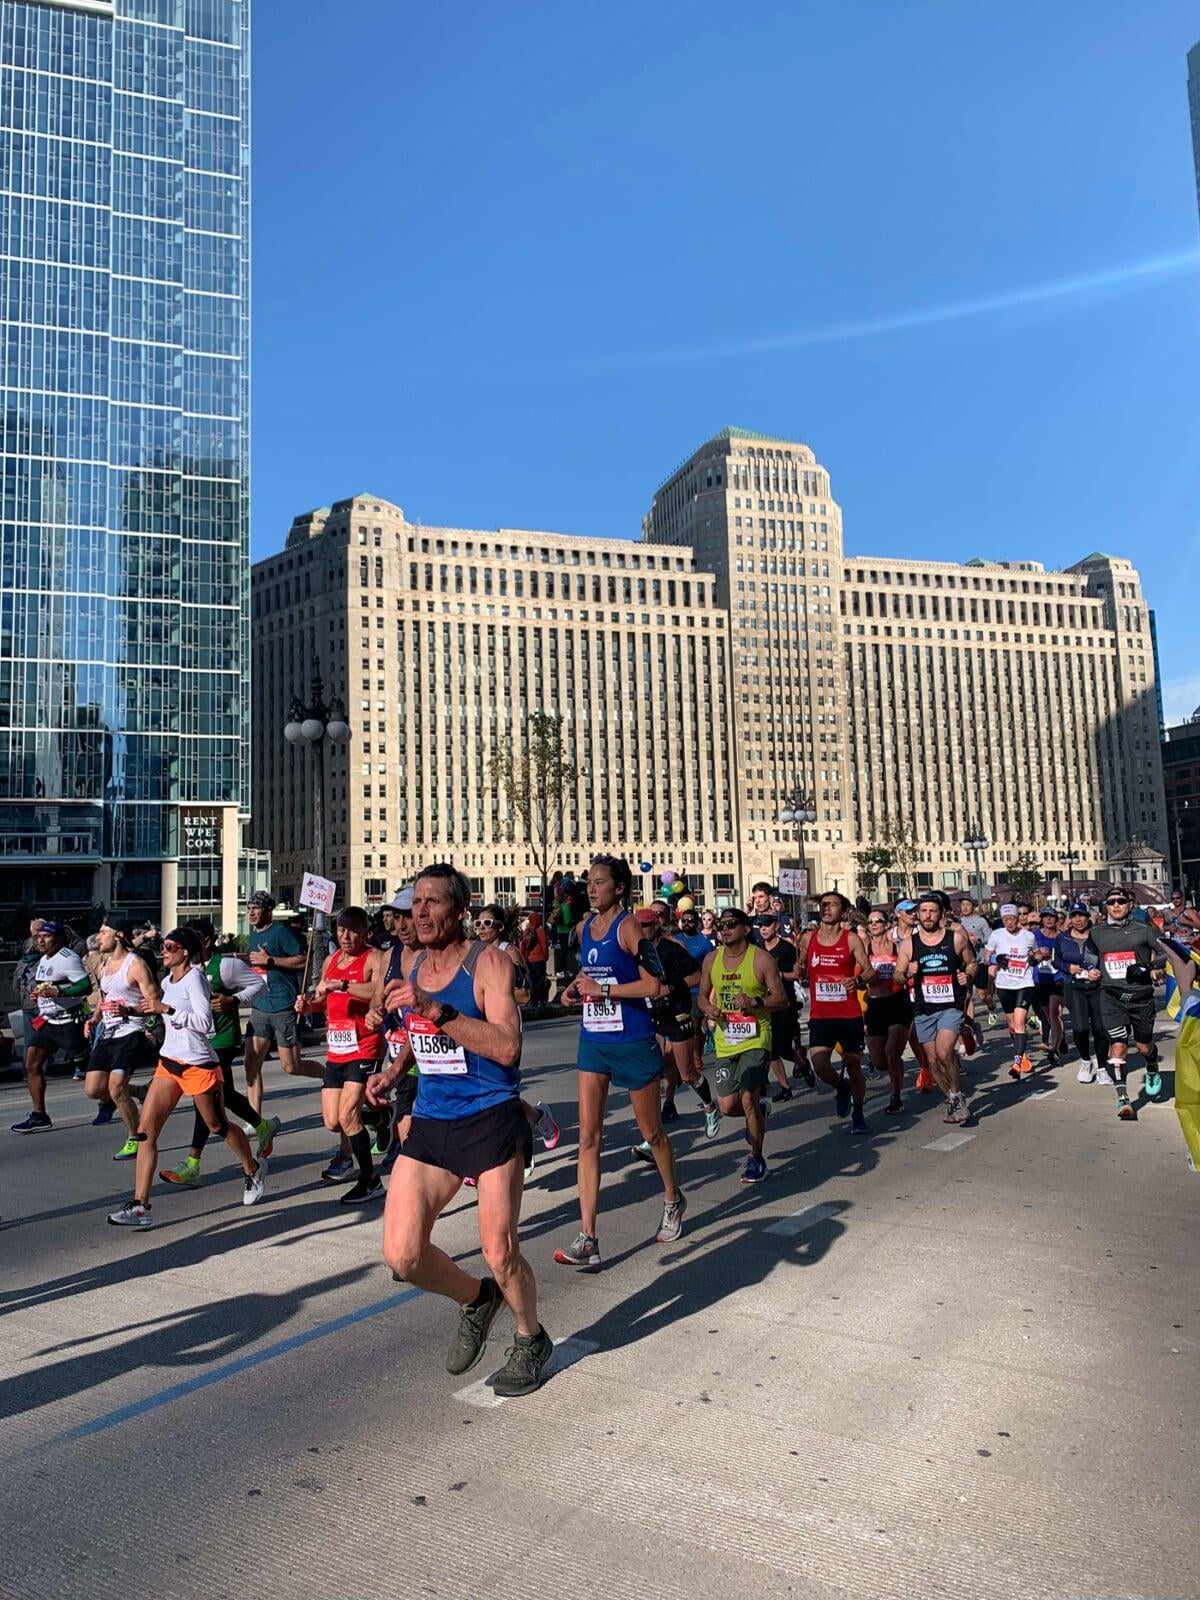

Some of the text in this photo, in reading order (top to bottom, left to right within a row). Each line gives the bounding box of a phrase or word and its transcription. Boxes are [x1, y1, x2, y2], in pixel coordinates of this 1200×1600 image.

[184, 816, 217, 826] RENT
[185, 828, 216, 837] WPE.
[186, 839, 216, 848] COM
[307, 890, 327, 902] 3:40
[919, 953, 948, 964] CHICAGO
[820, 983, 842, 992] E 8997
[926, 984, 950, 994] E 8970
[587, 1003, 617, 1017] E 8963
[727, 1023, 751, 1034] E 5950
[333, 1031, 352, 1042] 8998
[410, 1033, 417, 1052] E
[418, 1035, 458, 1055] 15864
